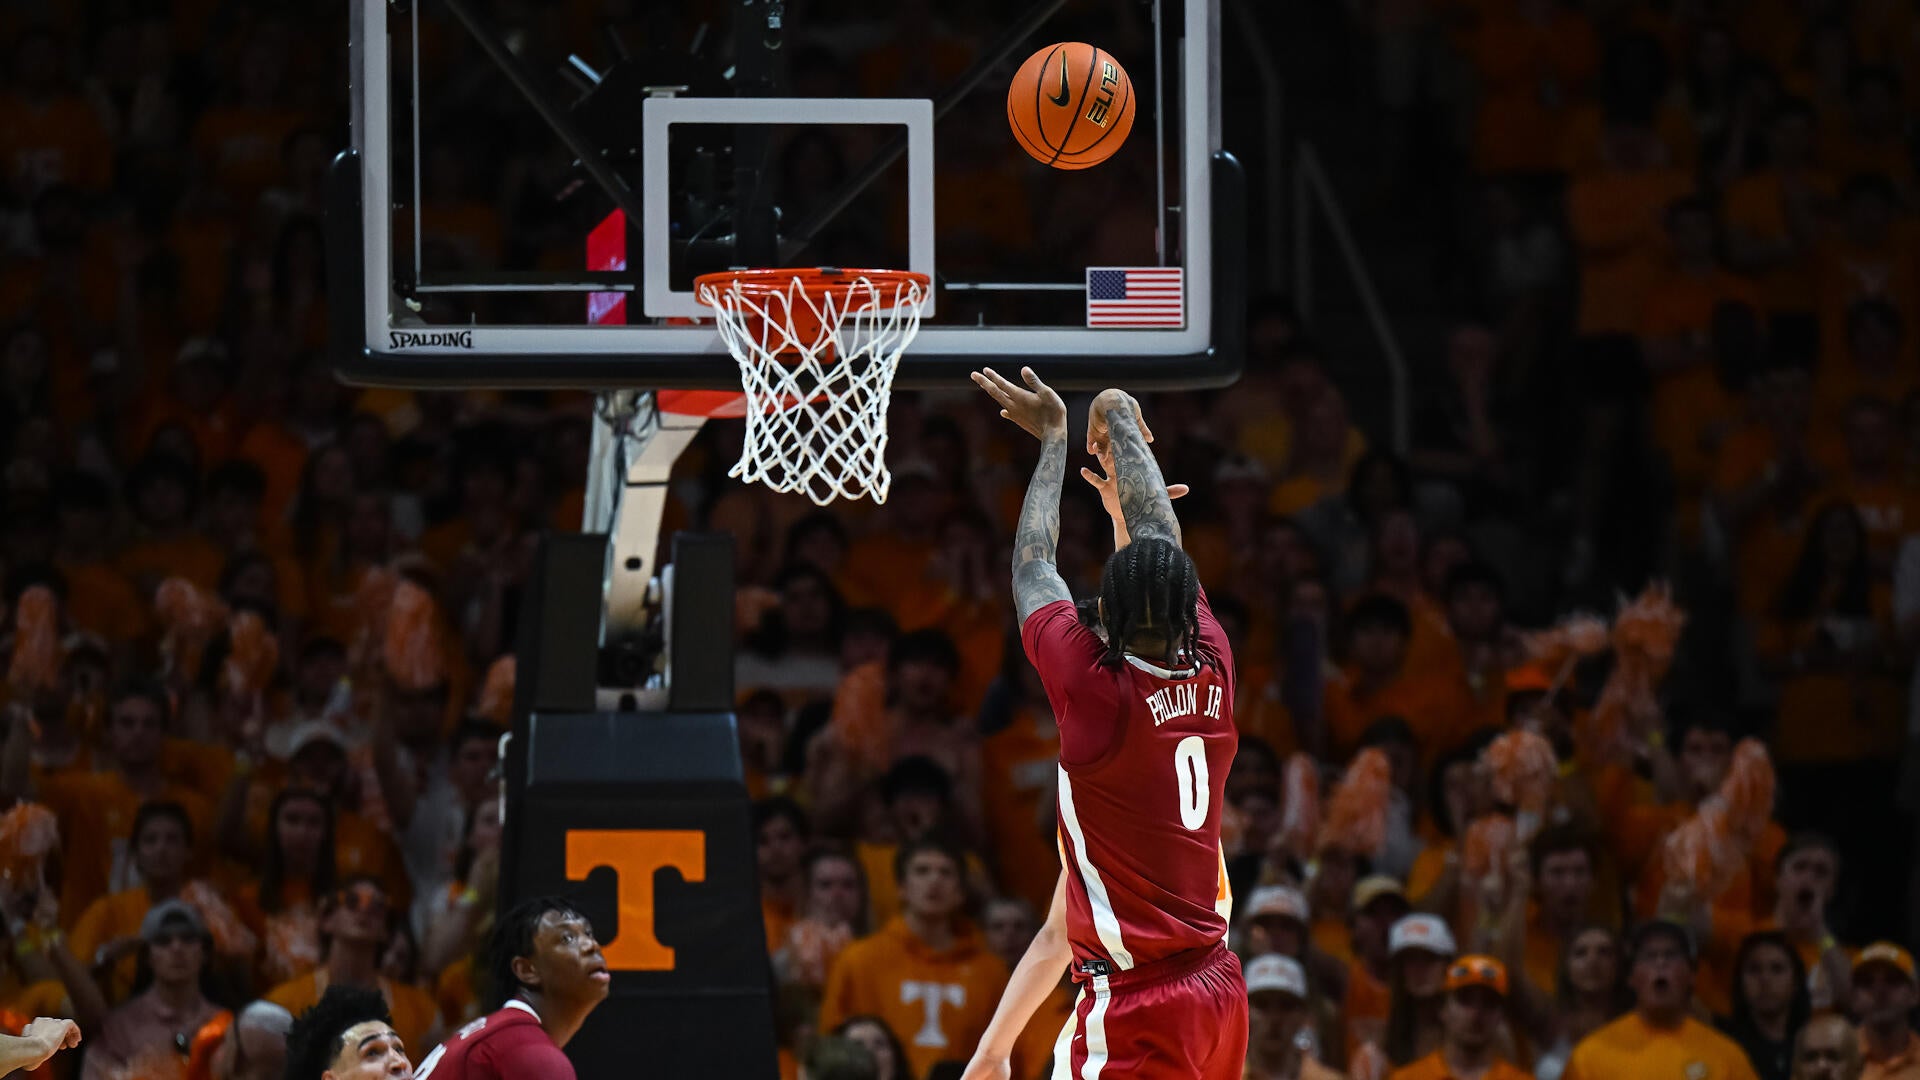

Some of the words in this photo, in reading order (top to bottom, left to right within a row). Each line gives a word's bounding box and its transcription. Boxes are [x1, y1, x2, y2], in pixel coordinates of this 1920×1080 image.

[1086, 61, 1118, 125] ELITE
[390, 331, 472, 349] SPALDING
[1203, 684, 1223, 720] JR
[1175, 735, 1210, 831] 0
[565, 829, 706, 971] T
[900, 981, 966, 1047] T
